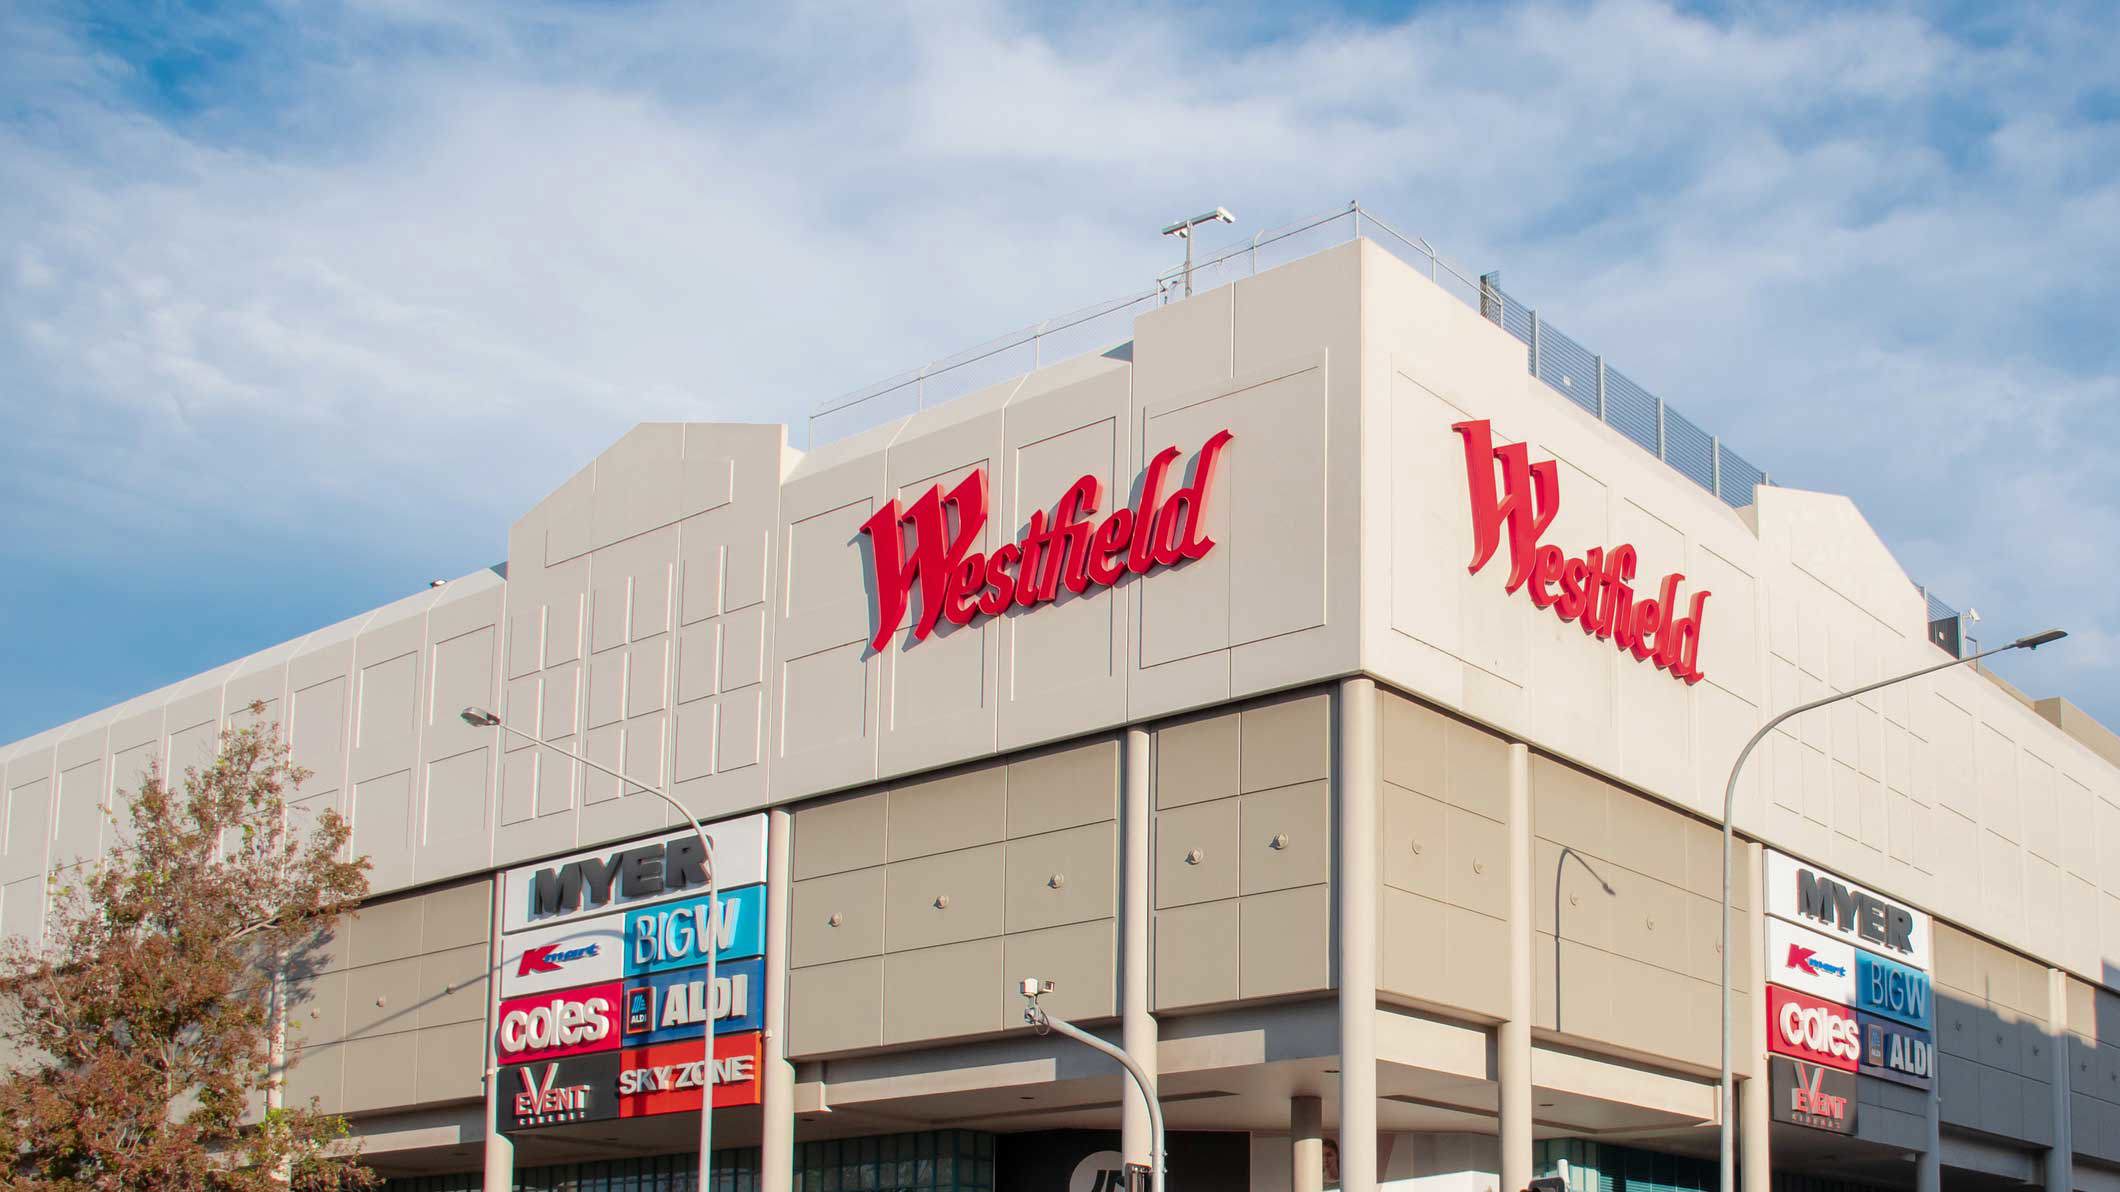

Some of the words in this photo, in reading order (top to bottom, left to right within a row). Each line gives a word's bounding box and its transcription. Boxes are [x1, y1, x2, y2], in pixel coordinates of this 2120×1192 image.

[859, 429, 1233, 653] Westfield
[1451, 419, 1712, 686] Westfield
[534, 834, 714, 914] MYER
[1796, 868, 1914, 955] MYER
[516, 942, 600, 977] Kmart
[661, 974, 748, 1027] ALDI
[1889, 1032, 1933, 1077] ALDI
[514, 1062, 591, 1116] EVENT
[1792, 1061, 1848, 1121] EVENT
